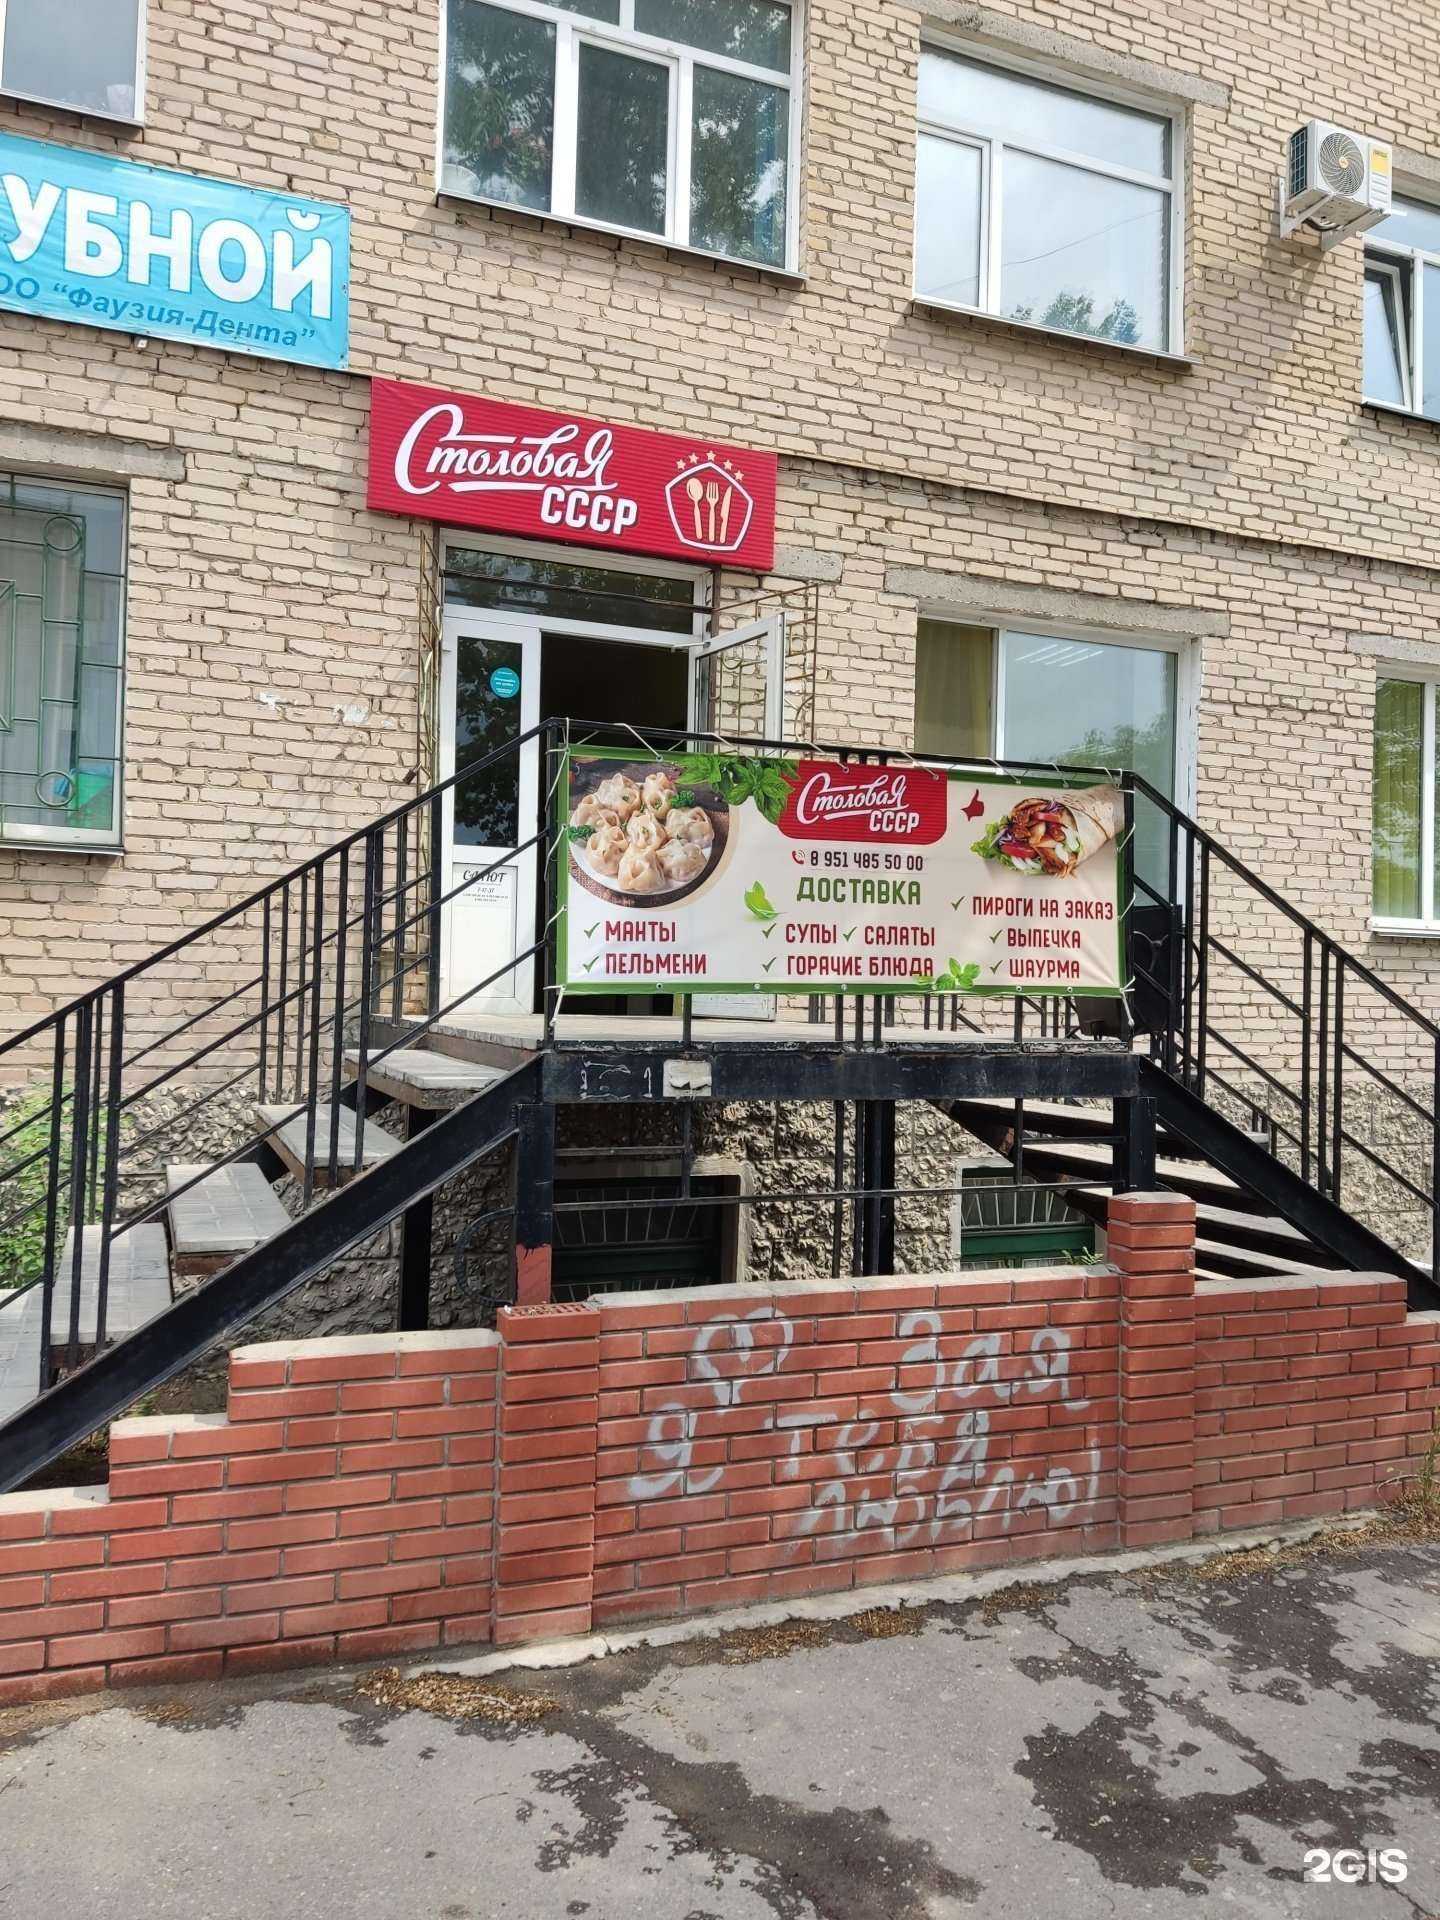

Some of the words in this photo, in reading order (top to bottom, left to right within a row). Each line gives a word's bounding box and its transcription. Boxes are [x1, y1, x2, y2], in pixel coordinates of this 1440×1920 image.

[394, 403, 618, 495] Столовая
[540, 485, 638, 535] СССР
[796, 772, 910, 825] Столовая
[868, 810, 920, 834] СССР
[810, 850, 819, 867] 8
[824, 851, 849, 868] 951
[853, 852, 880, 869] 485
[884, 853, 902, 871] 50
[906, 855, 924, 871] 00
[796, 876, 921, 905] ДОСТАВКА
[972, 896, 1033, 917] ПИРОГИ
[1039, 898, 1059, 918] НА
[1065, 900, 1114, 920] ЗАКАЗ
[605, 920, 677, 942] МАНТЫ
[785, 923, 837, 944] СУПЫ
[864, 925, 936, 947] САЛАТЫ
[1007, 927, 1081, 949] ВЫПЕЧКА
[605, 953, 707, 975] ПЕЛЬМЕНИ
[787, 955, 862, 976] ГОРЯЧИЕ
[869, 956, 934, 978] БЛЮДА
[1009, 958, 1080, 979] ШАУРМА
